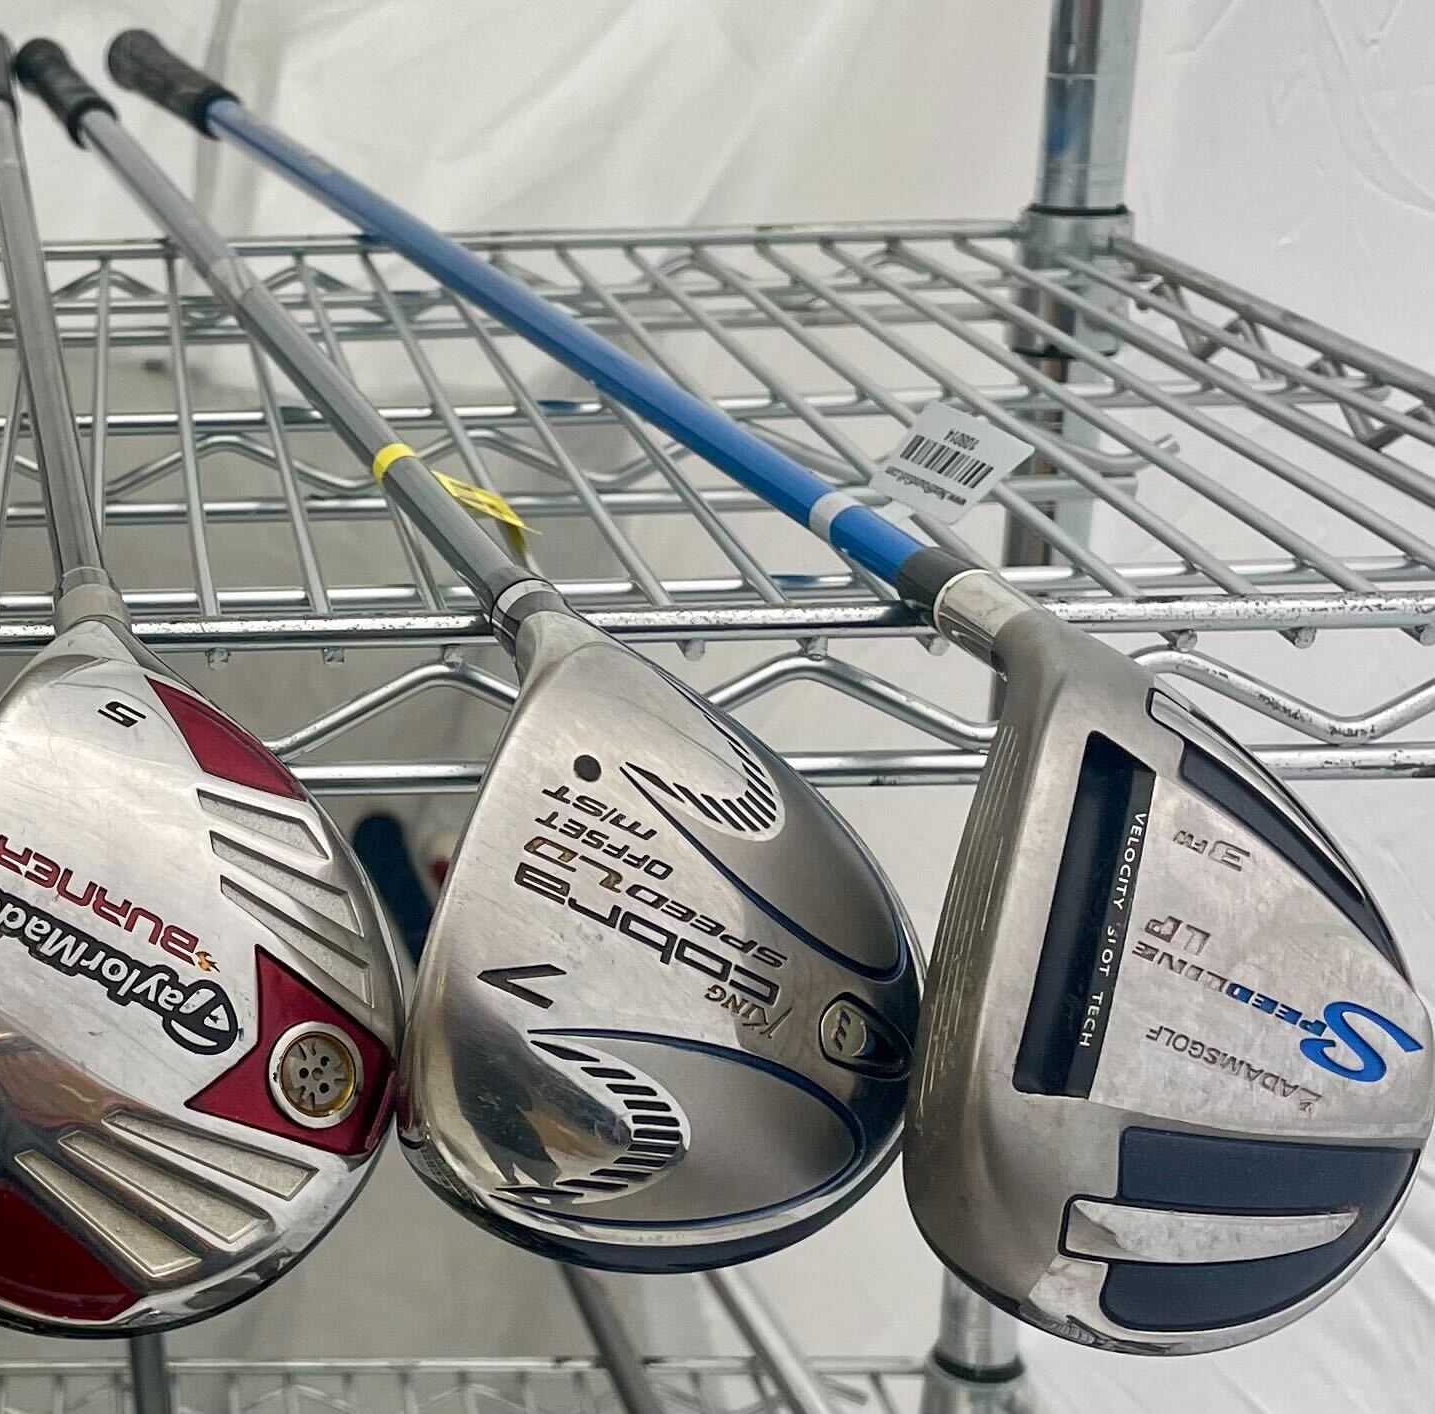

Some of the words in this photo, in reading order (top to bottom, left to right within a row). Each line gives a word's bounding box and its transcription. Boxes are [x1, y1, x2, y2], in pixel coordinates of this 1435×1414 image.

[97, 700, 146, 728] 5
[535, 811, 674, 879] OFFSET
[1113, 811, 1149, 911] VELOCITY
[1172, 829, 1208, 855] FW
[1209, 840, 1252, 872] 3
[514, 861, 780, 1006] cobra
[1144, 915, 1211, 954] LP
[1078, 990, 1105, 1049] TECH
